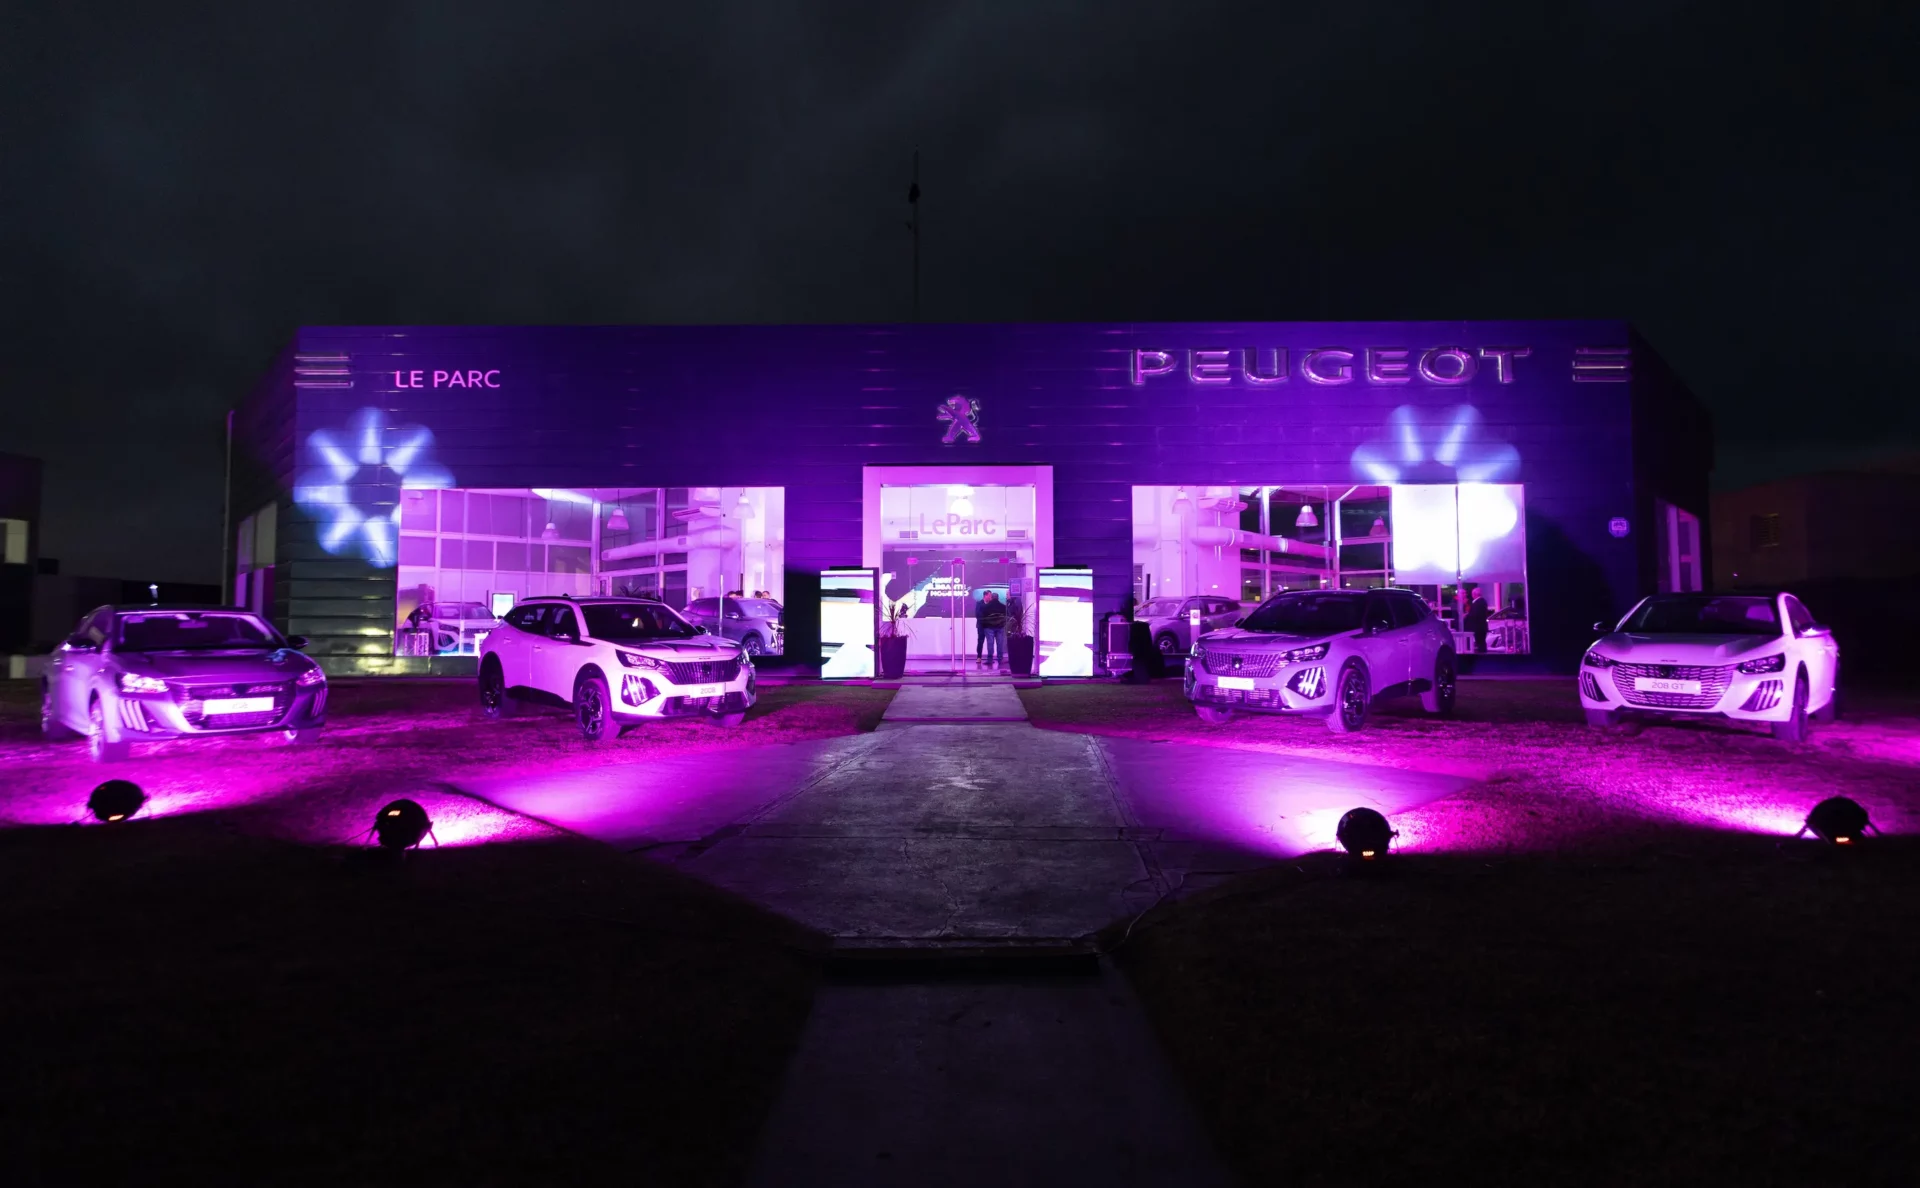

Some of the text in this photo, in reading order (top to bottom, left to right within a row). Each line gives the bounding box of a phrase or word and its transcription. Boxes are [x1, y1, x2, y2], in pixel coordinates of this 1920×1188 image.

[1130, 346, 1532, 386] PEUGEOT
[395, 369, 501, 388] LE PARC
[919, 512, 997, 535] LeParc
[1651, 681, 1685, 691] 208 GT
